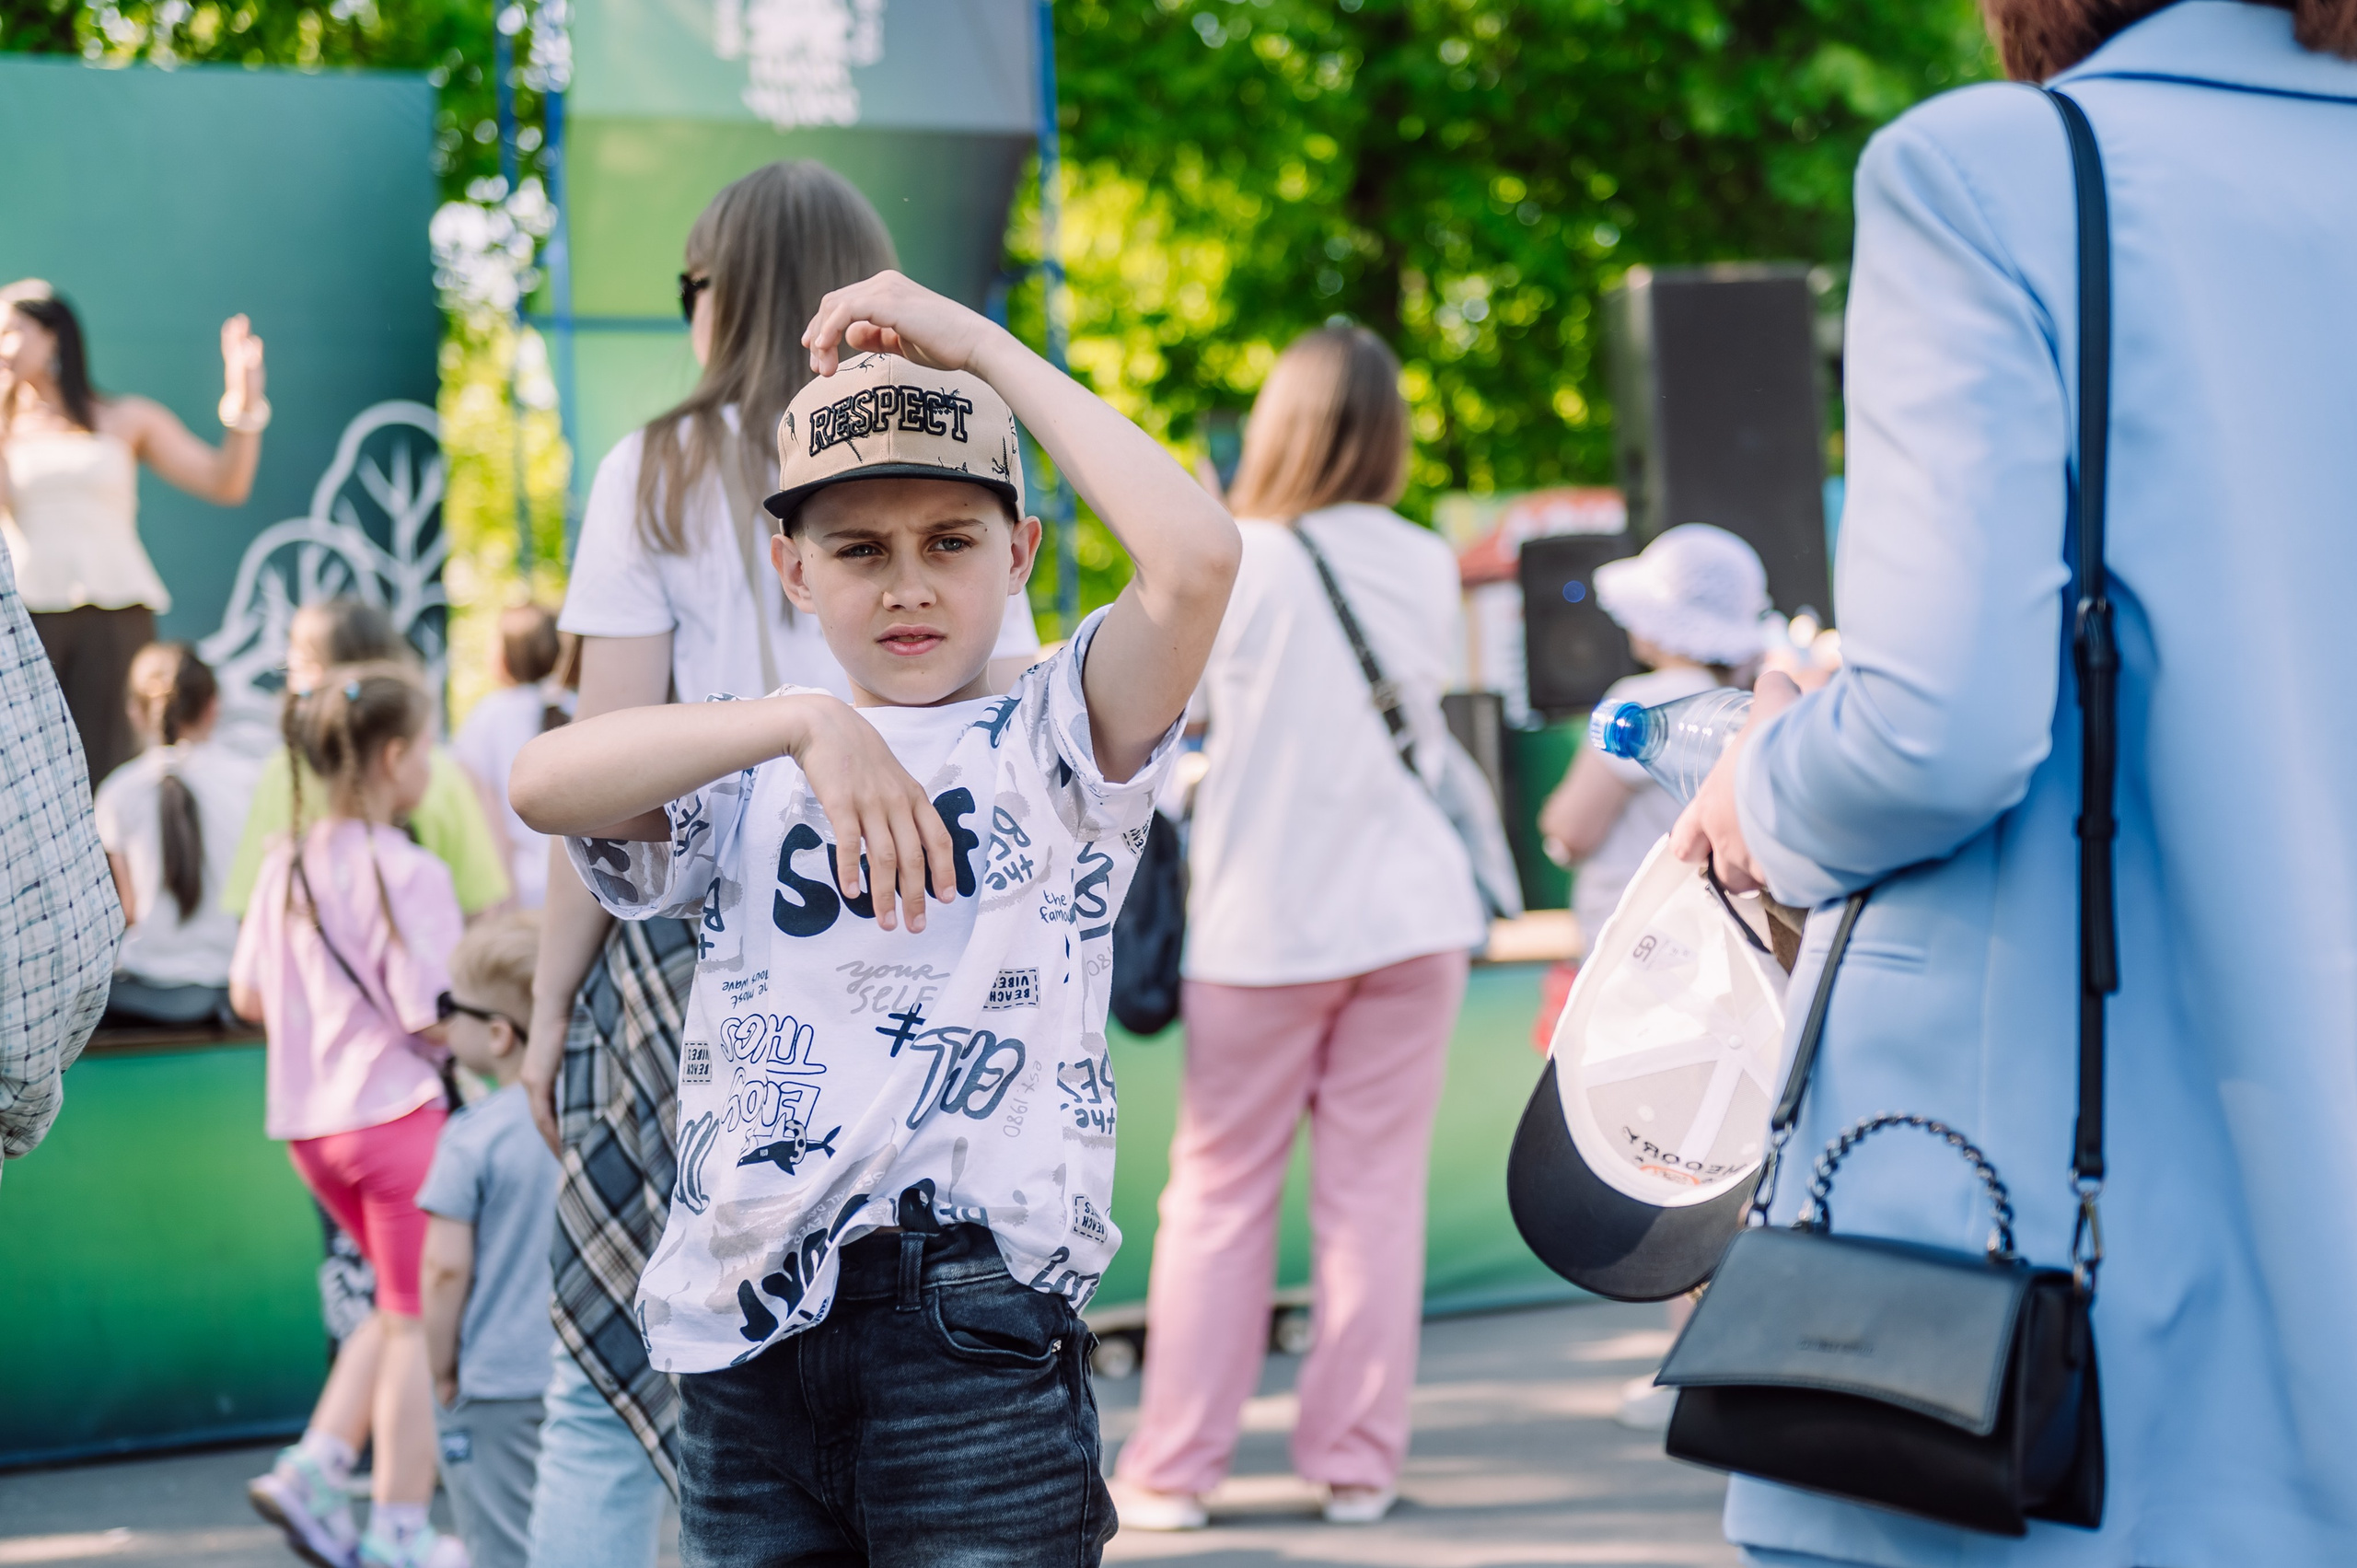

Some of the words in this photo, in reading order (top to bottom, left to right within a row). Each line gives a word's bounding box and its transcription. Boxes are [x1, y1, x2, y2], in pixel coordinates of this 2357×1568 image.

[808, 384, 973, 458] RESPECT
[1042, 889, 1068, 907] the
[989, 987, 1030, 1003] BEACH
[1074, 1107, 1116, 1135] the
